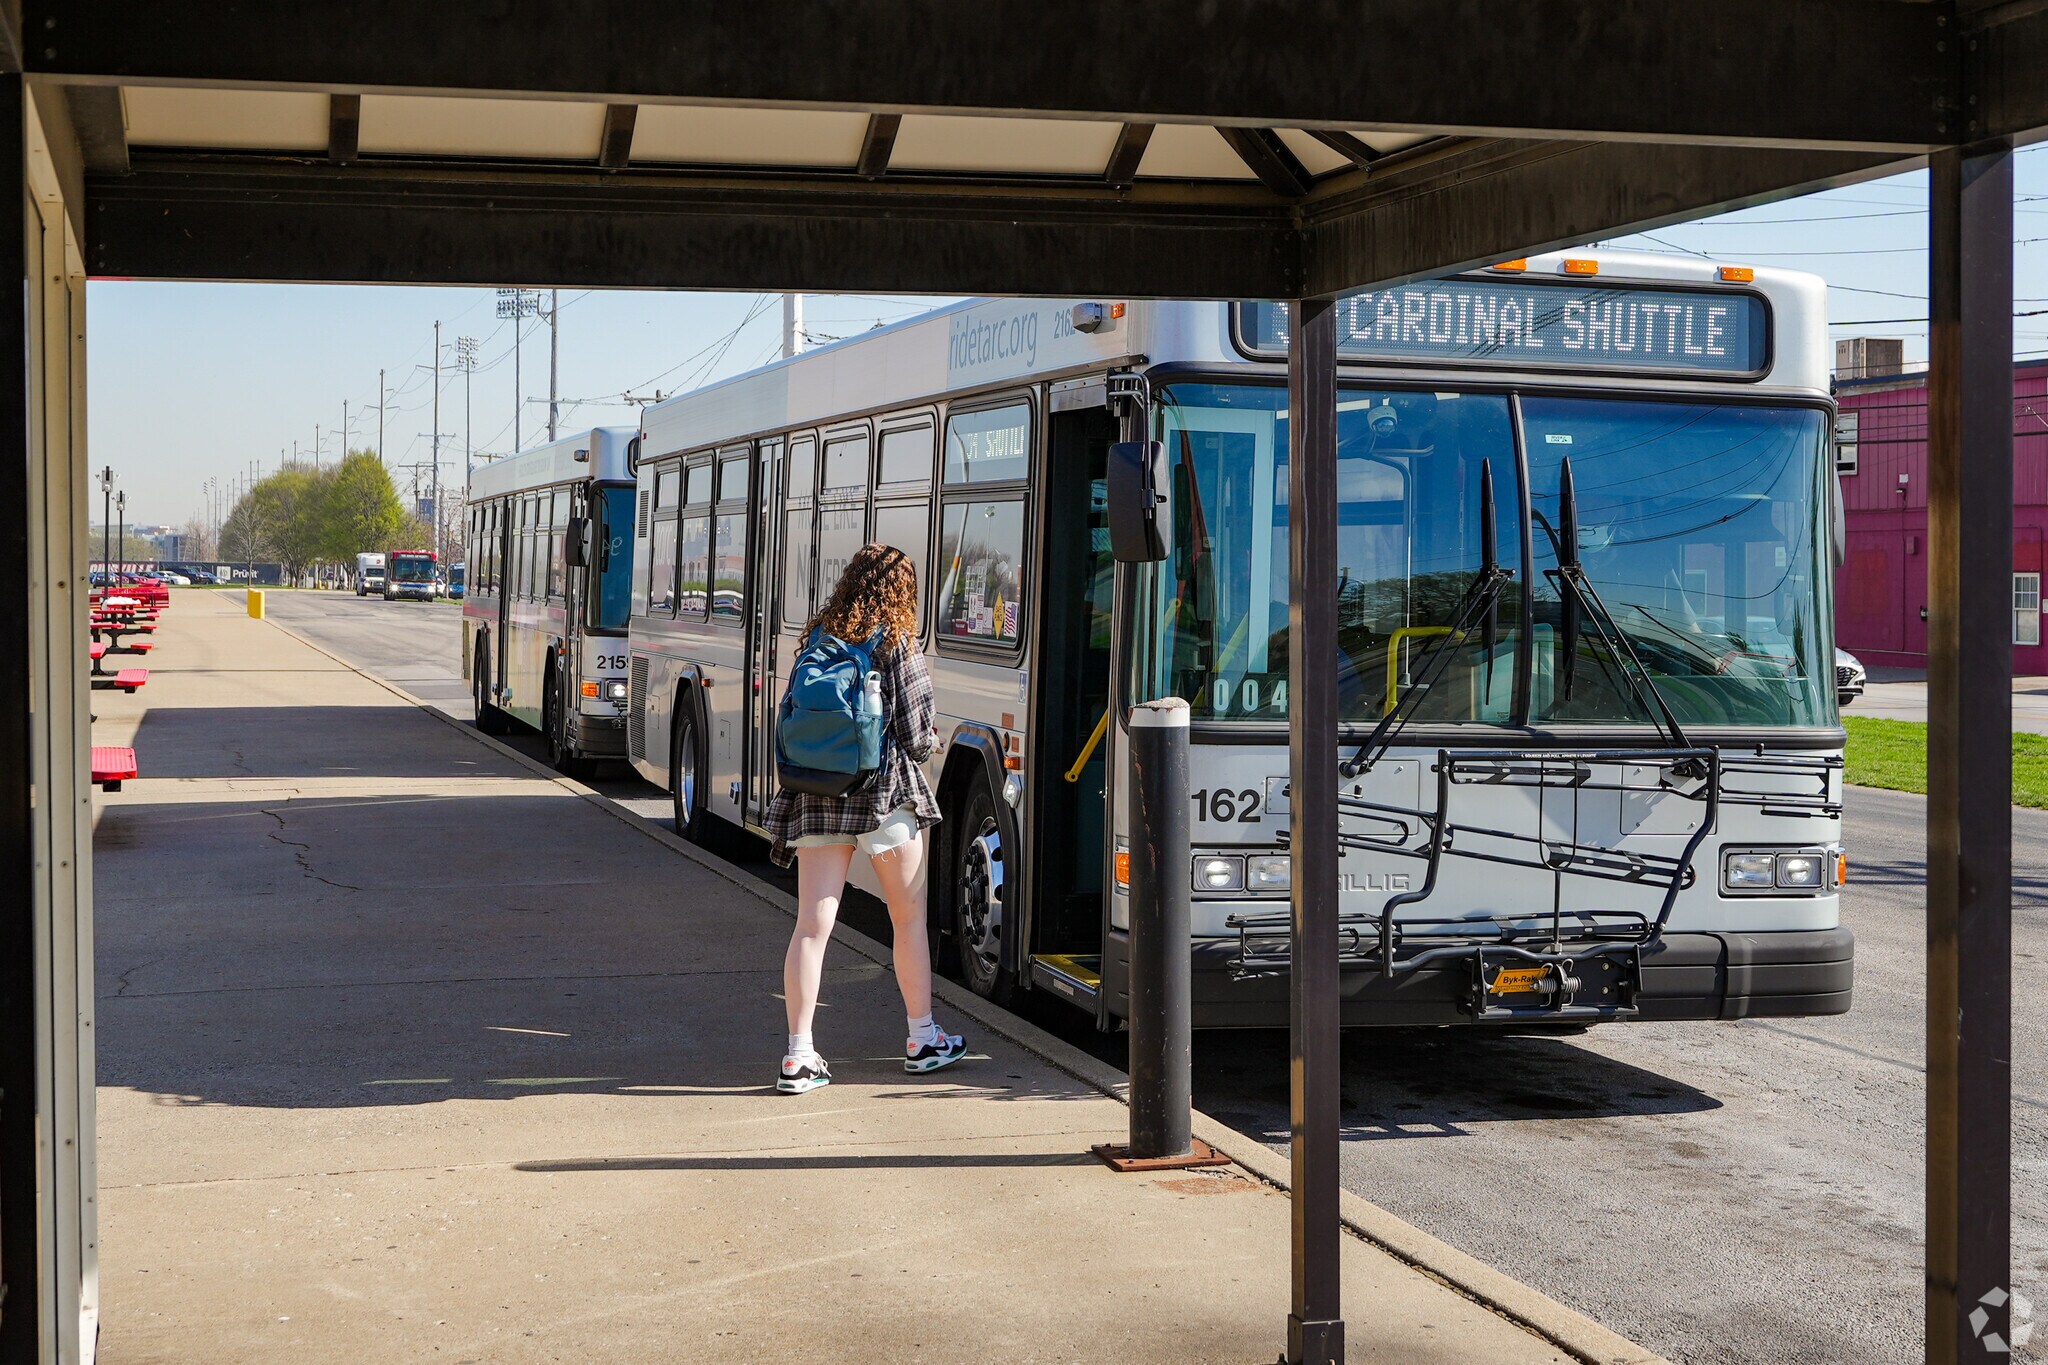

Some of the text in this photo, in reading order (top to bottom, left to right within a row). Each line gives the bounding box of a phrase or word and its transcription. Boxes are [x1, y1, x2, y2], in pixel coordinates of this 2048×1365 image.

[1349, 291, 1543, 347] CARDINAL
[1563, 300, 1727, 355] SHUTTLE
[949, 311, 1038, 371] ridetarc.org
[597, 655, 629, 669] 215
[1191, 788, 1261, 823] 162
[1338, 873, 1410, 892] ILLIG
